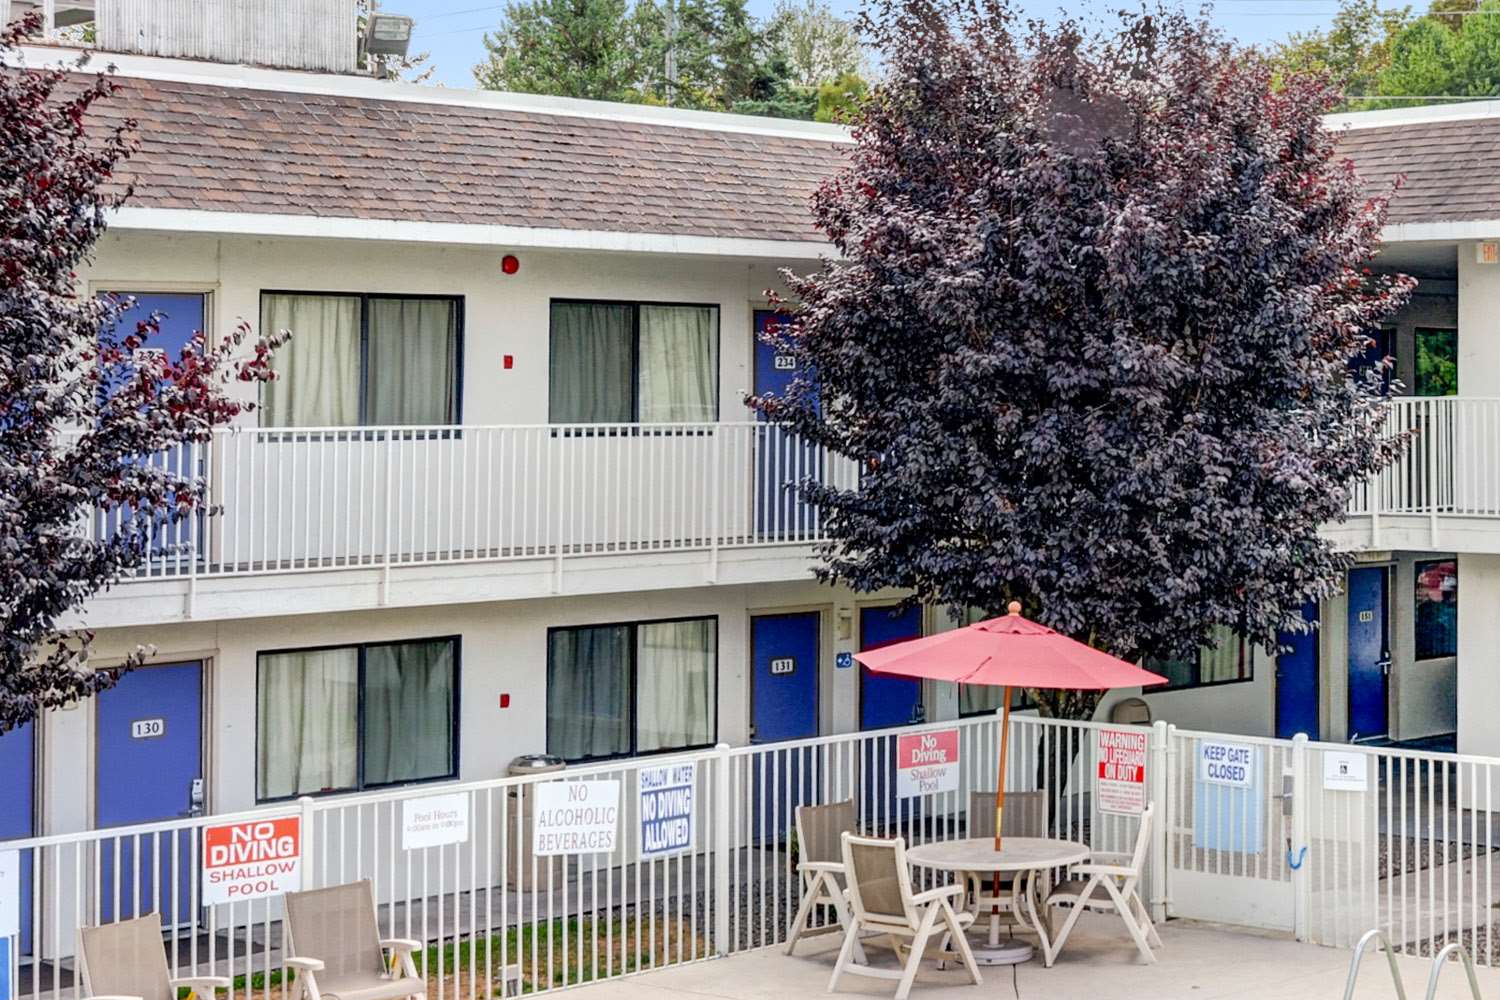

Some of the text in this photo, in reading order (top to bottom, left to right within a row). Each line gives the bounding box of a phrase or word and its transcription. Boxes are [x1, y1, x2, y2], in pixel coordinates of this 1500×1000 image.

[775, 660, 790, 672] 131
[137, 722, 160, 735] 130
[921, 735, 937, 751] No
[1100, 731, 1145, 752] WARNING
[912, 749, 947, 763] Diving
[1204, 746, 1249, 765] KEEP GATE
[641, 765, 693, 789] SHALLOW WATER
[911, 768, 946, 781] Shallow
[1105, 763, 1138, 781] ON DUTY
[1208, 763, 1245, 781] CLOSED
[568, 784, 589, 802] NO
[920, 778, 939, 792] Pool
[642, 787, 691, 822] NO DIVING
[538, 807, 616, 828] ALCOHOLIC
[231, 822, 274, 843] NO
[538, 830, 613, 851] BEVERAGES
[645, 818, 689, 851] ALLOWED
[210, 835, 295, 866] DIVING
[209, 861, 296, 883] SHALLOW
[228, 880, 279, 897] POOL
